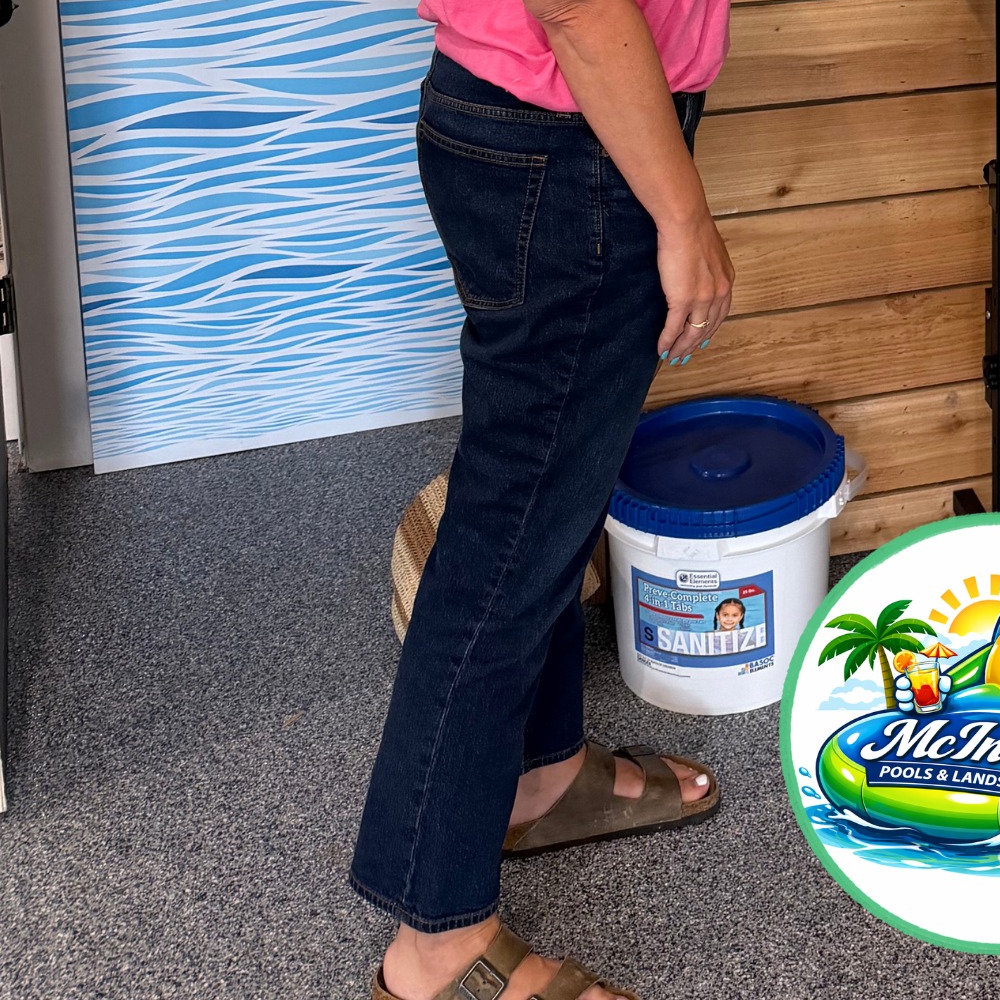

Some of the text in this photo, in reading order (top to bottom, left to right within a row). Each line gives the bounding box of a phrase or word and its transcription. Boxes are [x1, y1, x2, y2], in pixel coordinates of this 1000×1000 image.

[671, 602, 692, 612] Tabs
[644, 626, 654, 641] S
[658, 623, 766, 655] SANITIZE
[749, 656, 774, 669] BASOC
